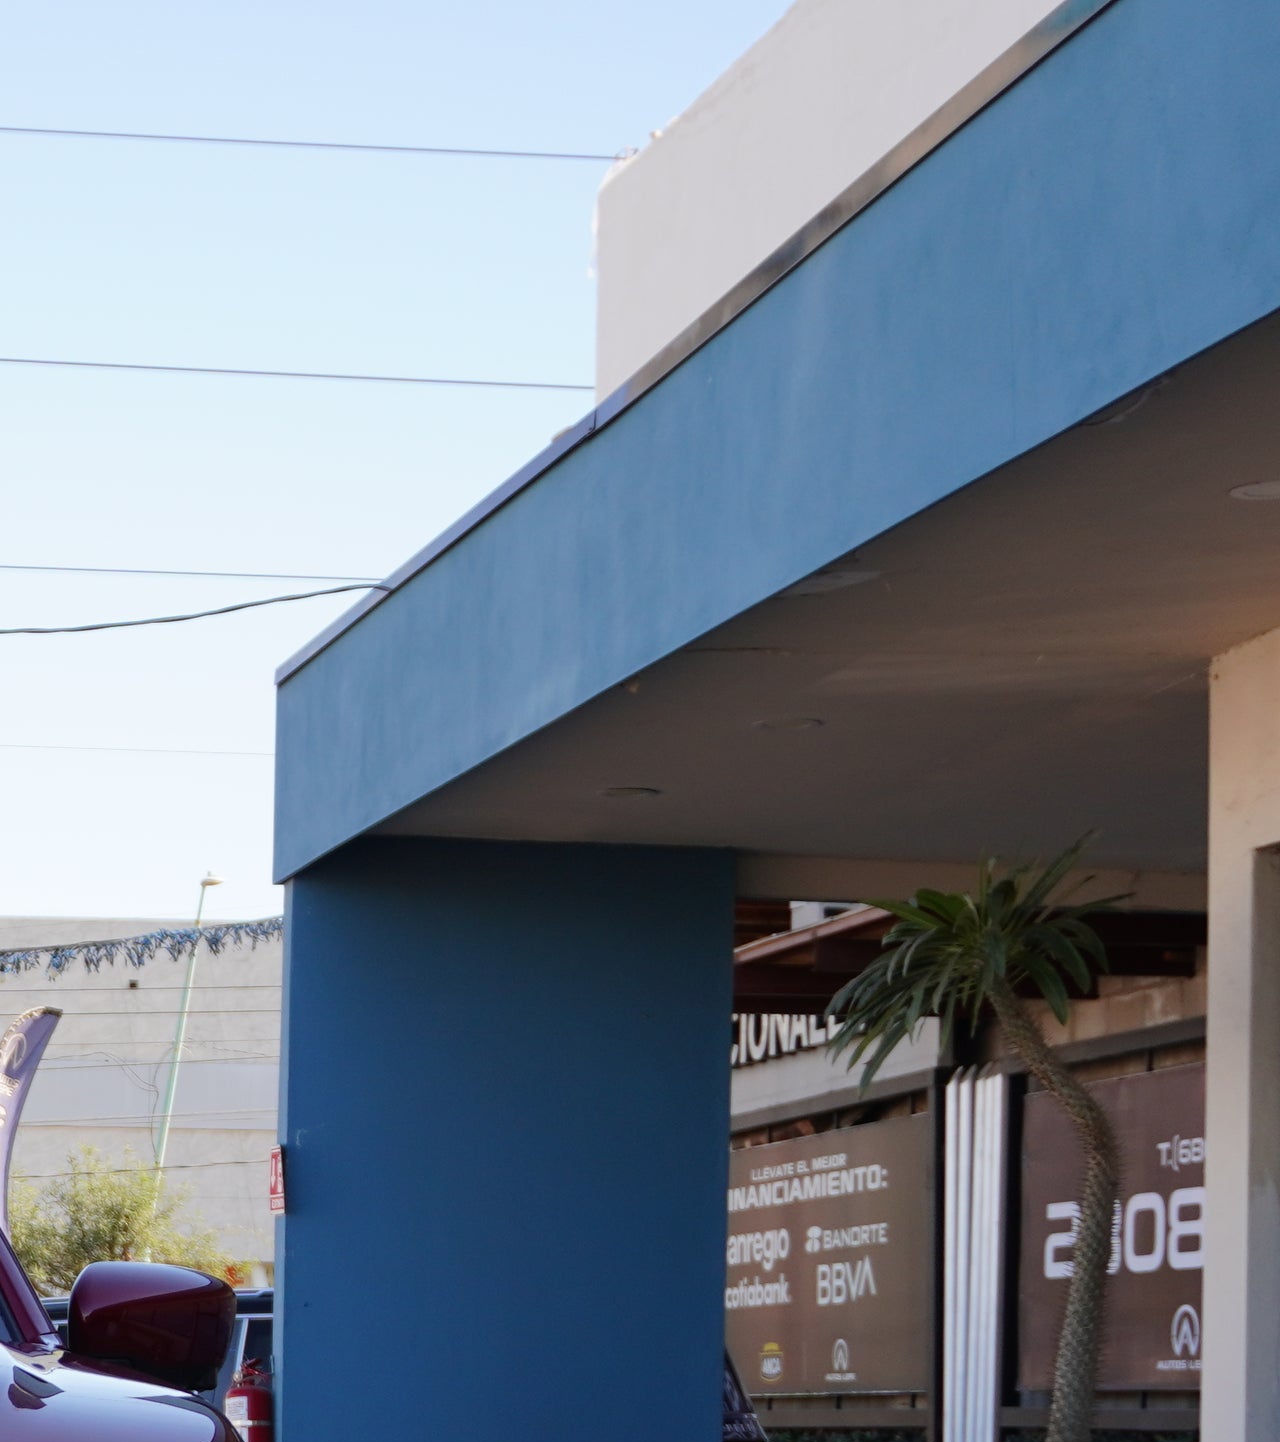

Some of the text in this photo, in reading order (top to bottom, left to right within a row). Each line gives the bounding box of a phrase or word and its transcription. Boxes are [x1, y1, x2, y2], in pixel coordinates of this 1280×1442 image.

[752, 1153, 847, 1180] LLEVATE EL MEJOR
[823, 1222, 888, 1249] BANORTE
[1044, 1187, 1206, 1279] 208
[817, 1255, 877, 1305] BBVA
